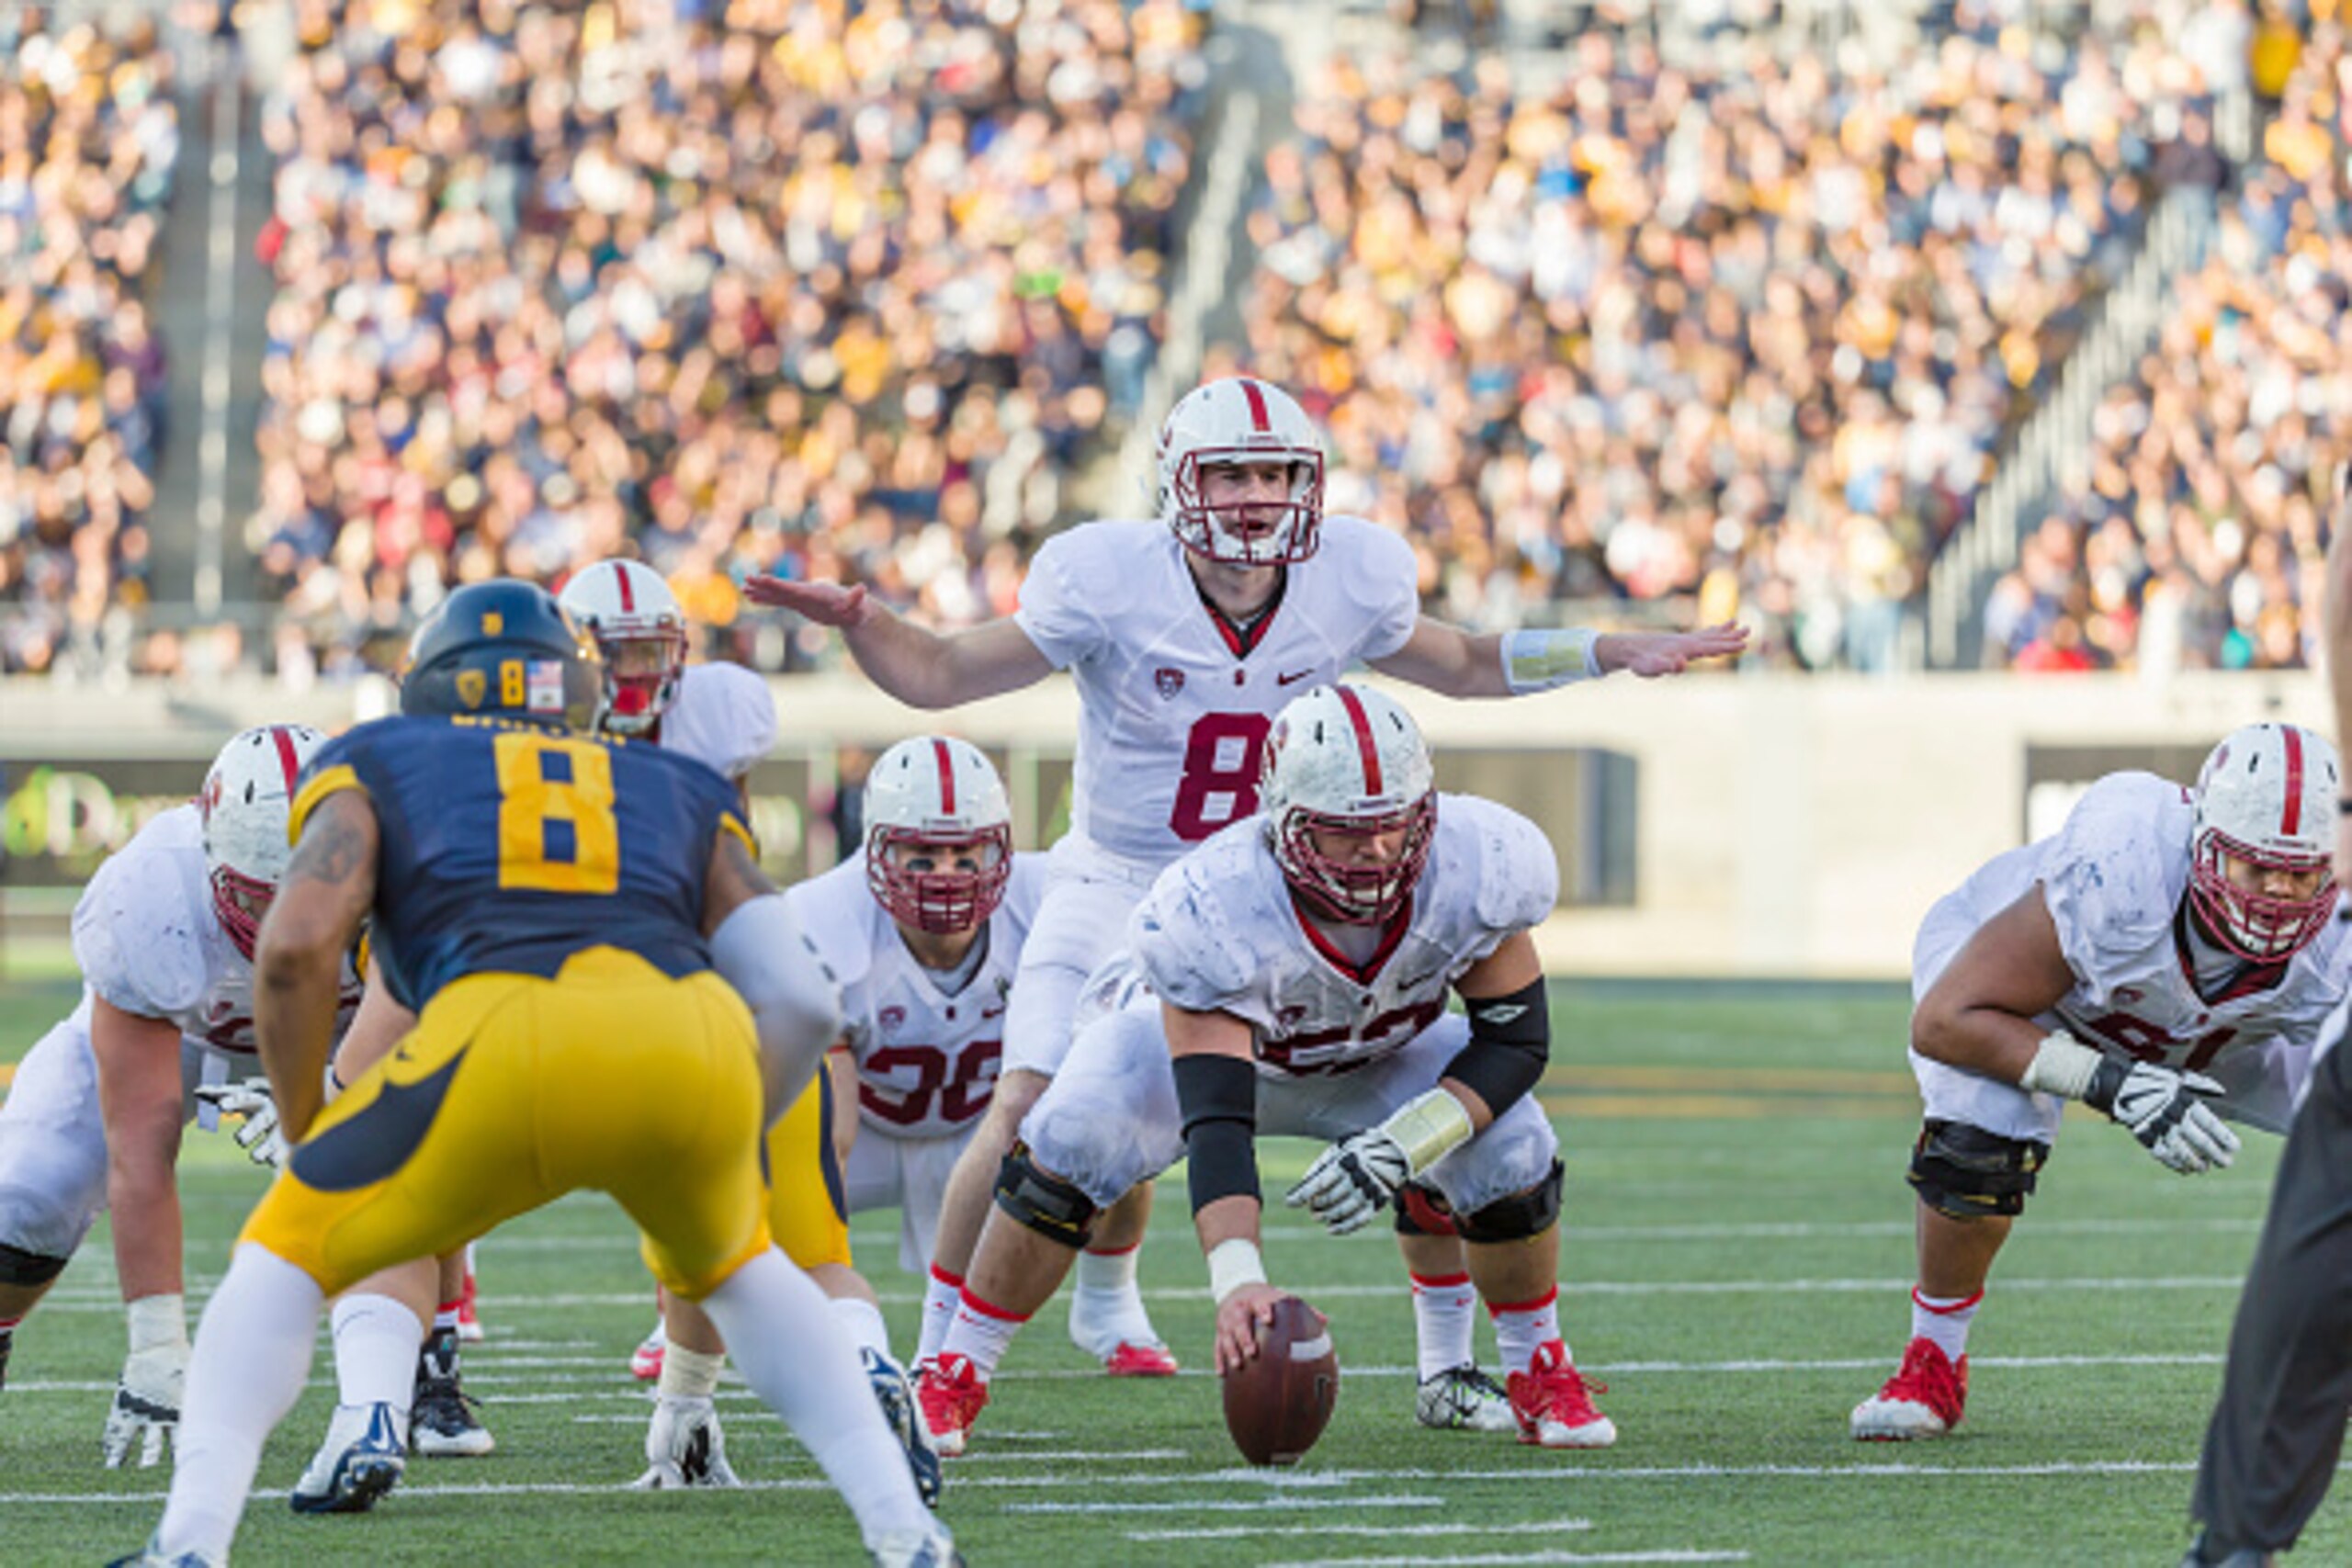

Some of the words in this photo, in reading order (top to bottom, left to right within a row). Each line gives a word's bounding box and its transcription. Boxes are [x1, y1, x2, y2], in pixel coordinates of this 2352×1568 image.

[500, 659, 525, 706] 8
[493, 732, 620, 893] 8
[1168, 712, 1272, 842] 8
